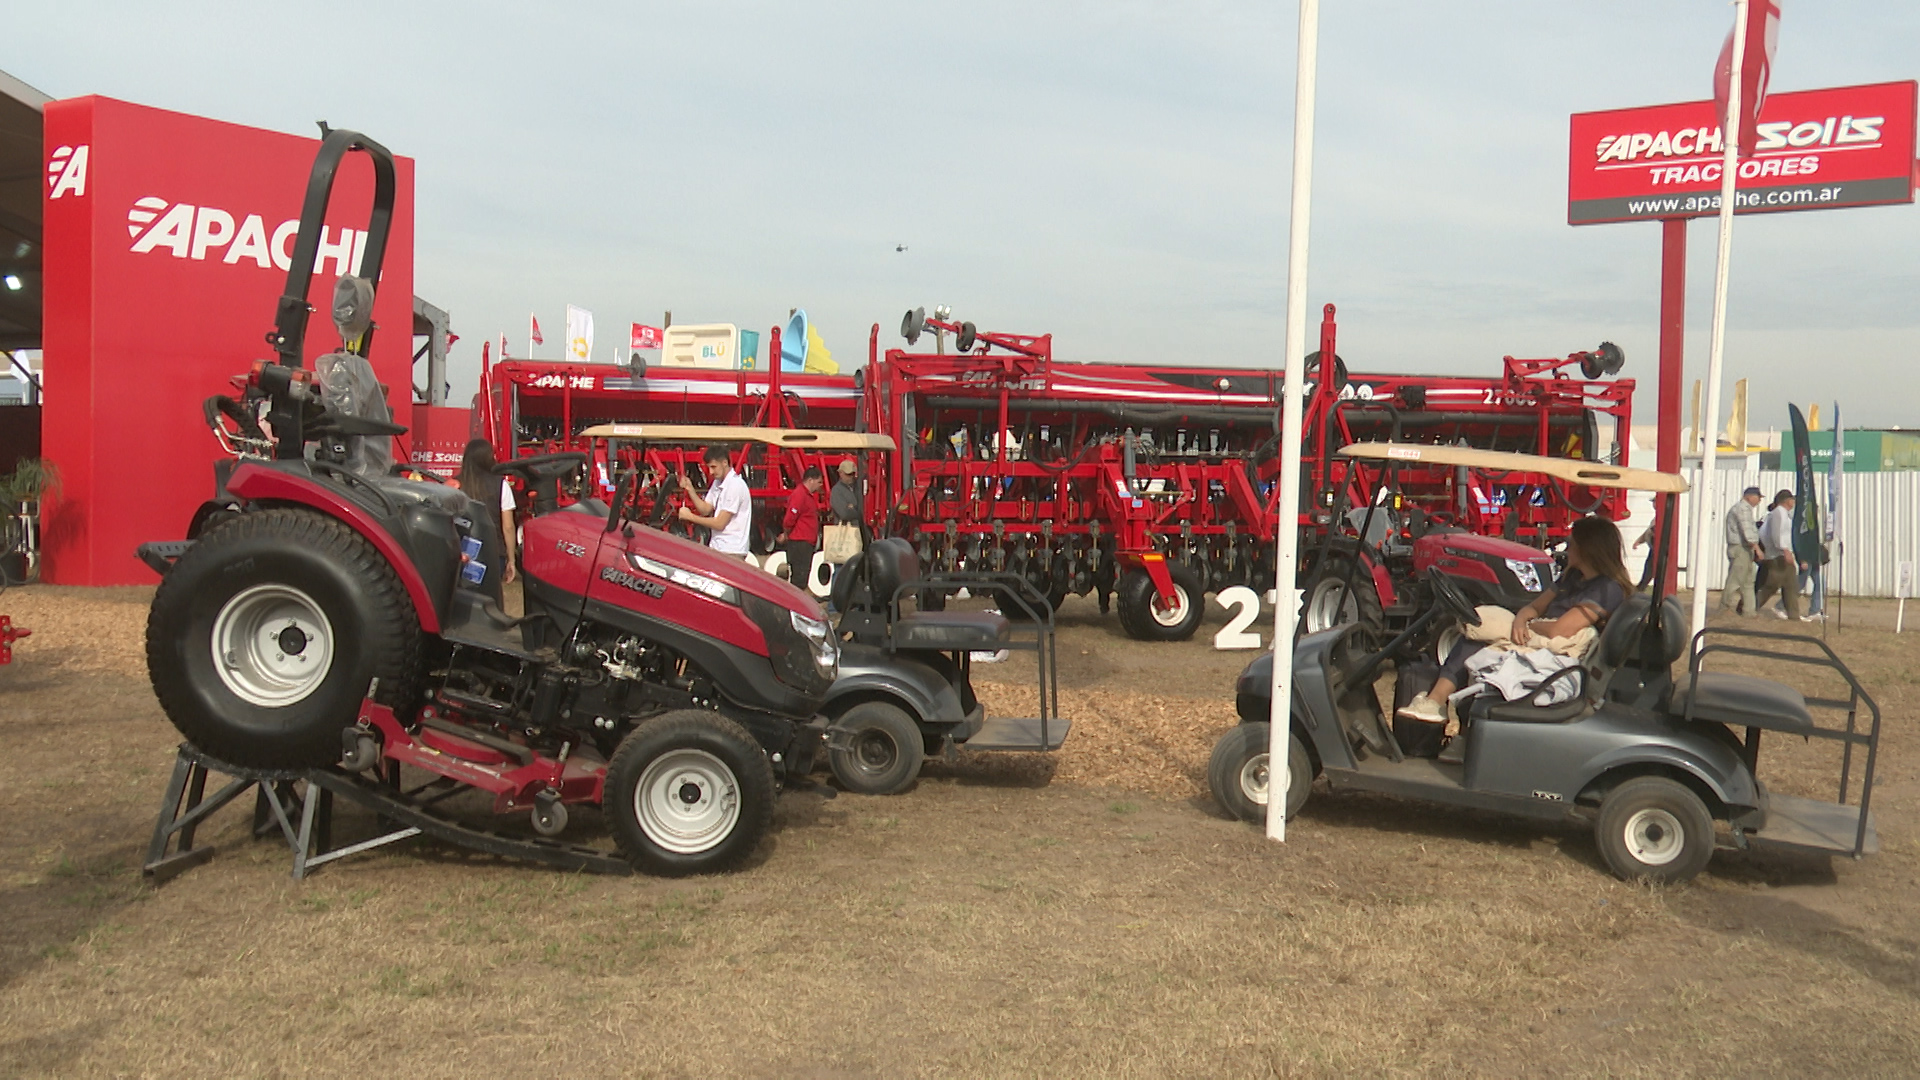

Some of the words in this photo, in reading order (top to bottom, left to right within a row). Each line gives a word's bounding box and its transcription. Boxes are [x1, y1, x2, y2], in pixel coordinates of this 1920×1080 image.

[1596, 126, 1725, 163] APACH
[1650, 156, 1819, 186] TRACORES
[1629, 185, 1842, 214] www.apahe.com.ar
[600, 566, 667, 599] APACHE
